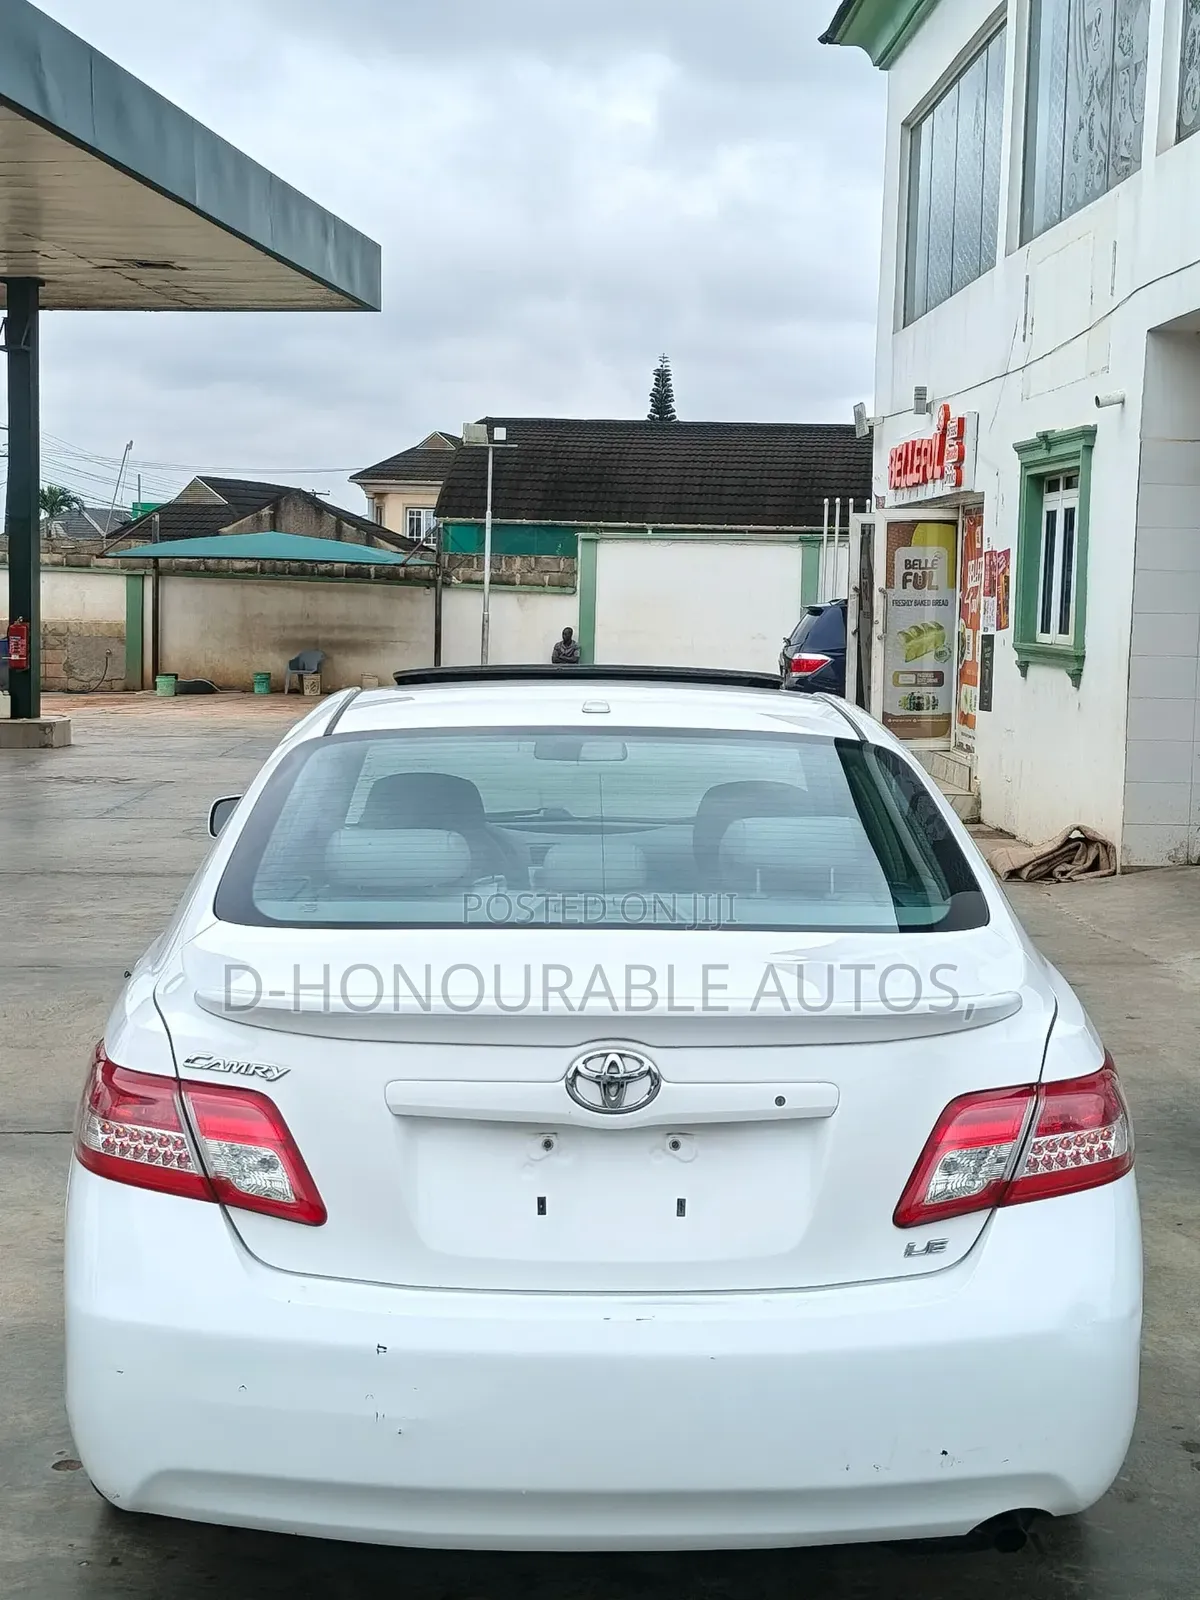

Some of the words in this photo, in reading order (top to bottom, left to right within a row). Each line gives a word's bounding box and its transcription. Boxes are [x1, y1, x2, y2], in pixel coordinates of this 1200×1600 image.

[904, 558, 939, 570] BELLE
[902, 570, 939, 590] FUL
[892, 599, 913, 607] FRESHLY
[914, 599, 930, 607] BAKED
[932, 599, 949, 607] BREAD
[183, 1052, 291, 1081] CAMRY
[904, 1239, 949, 1257] LE
